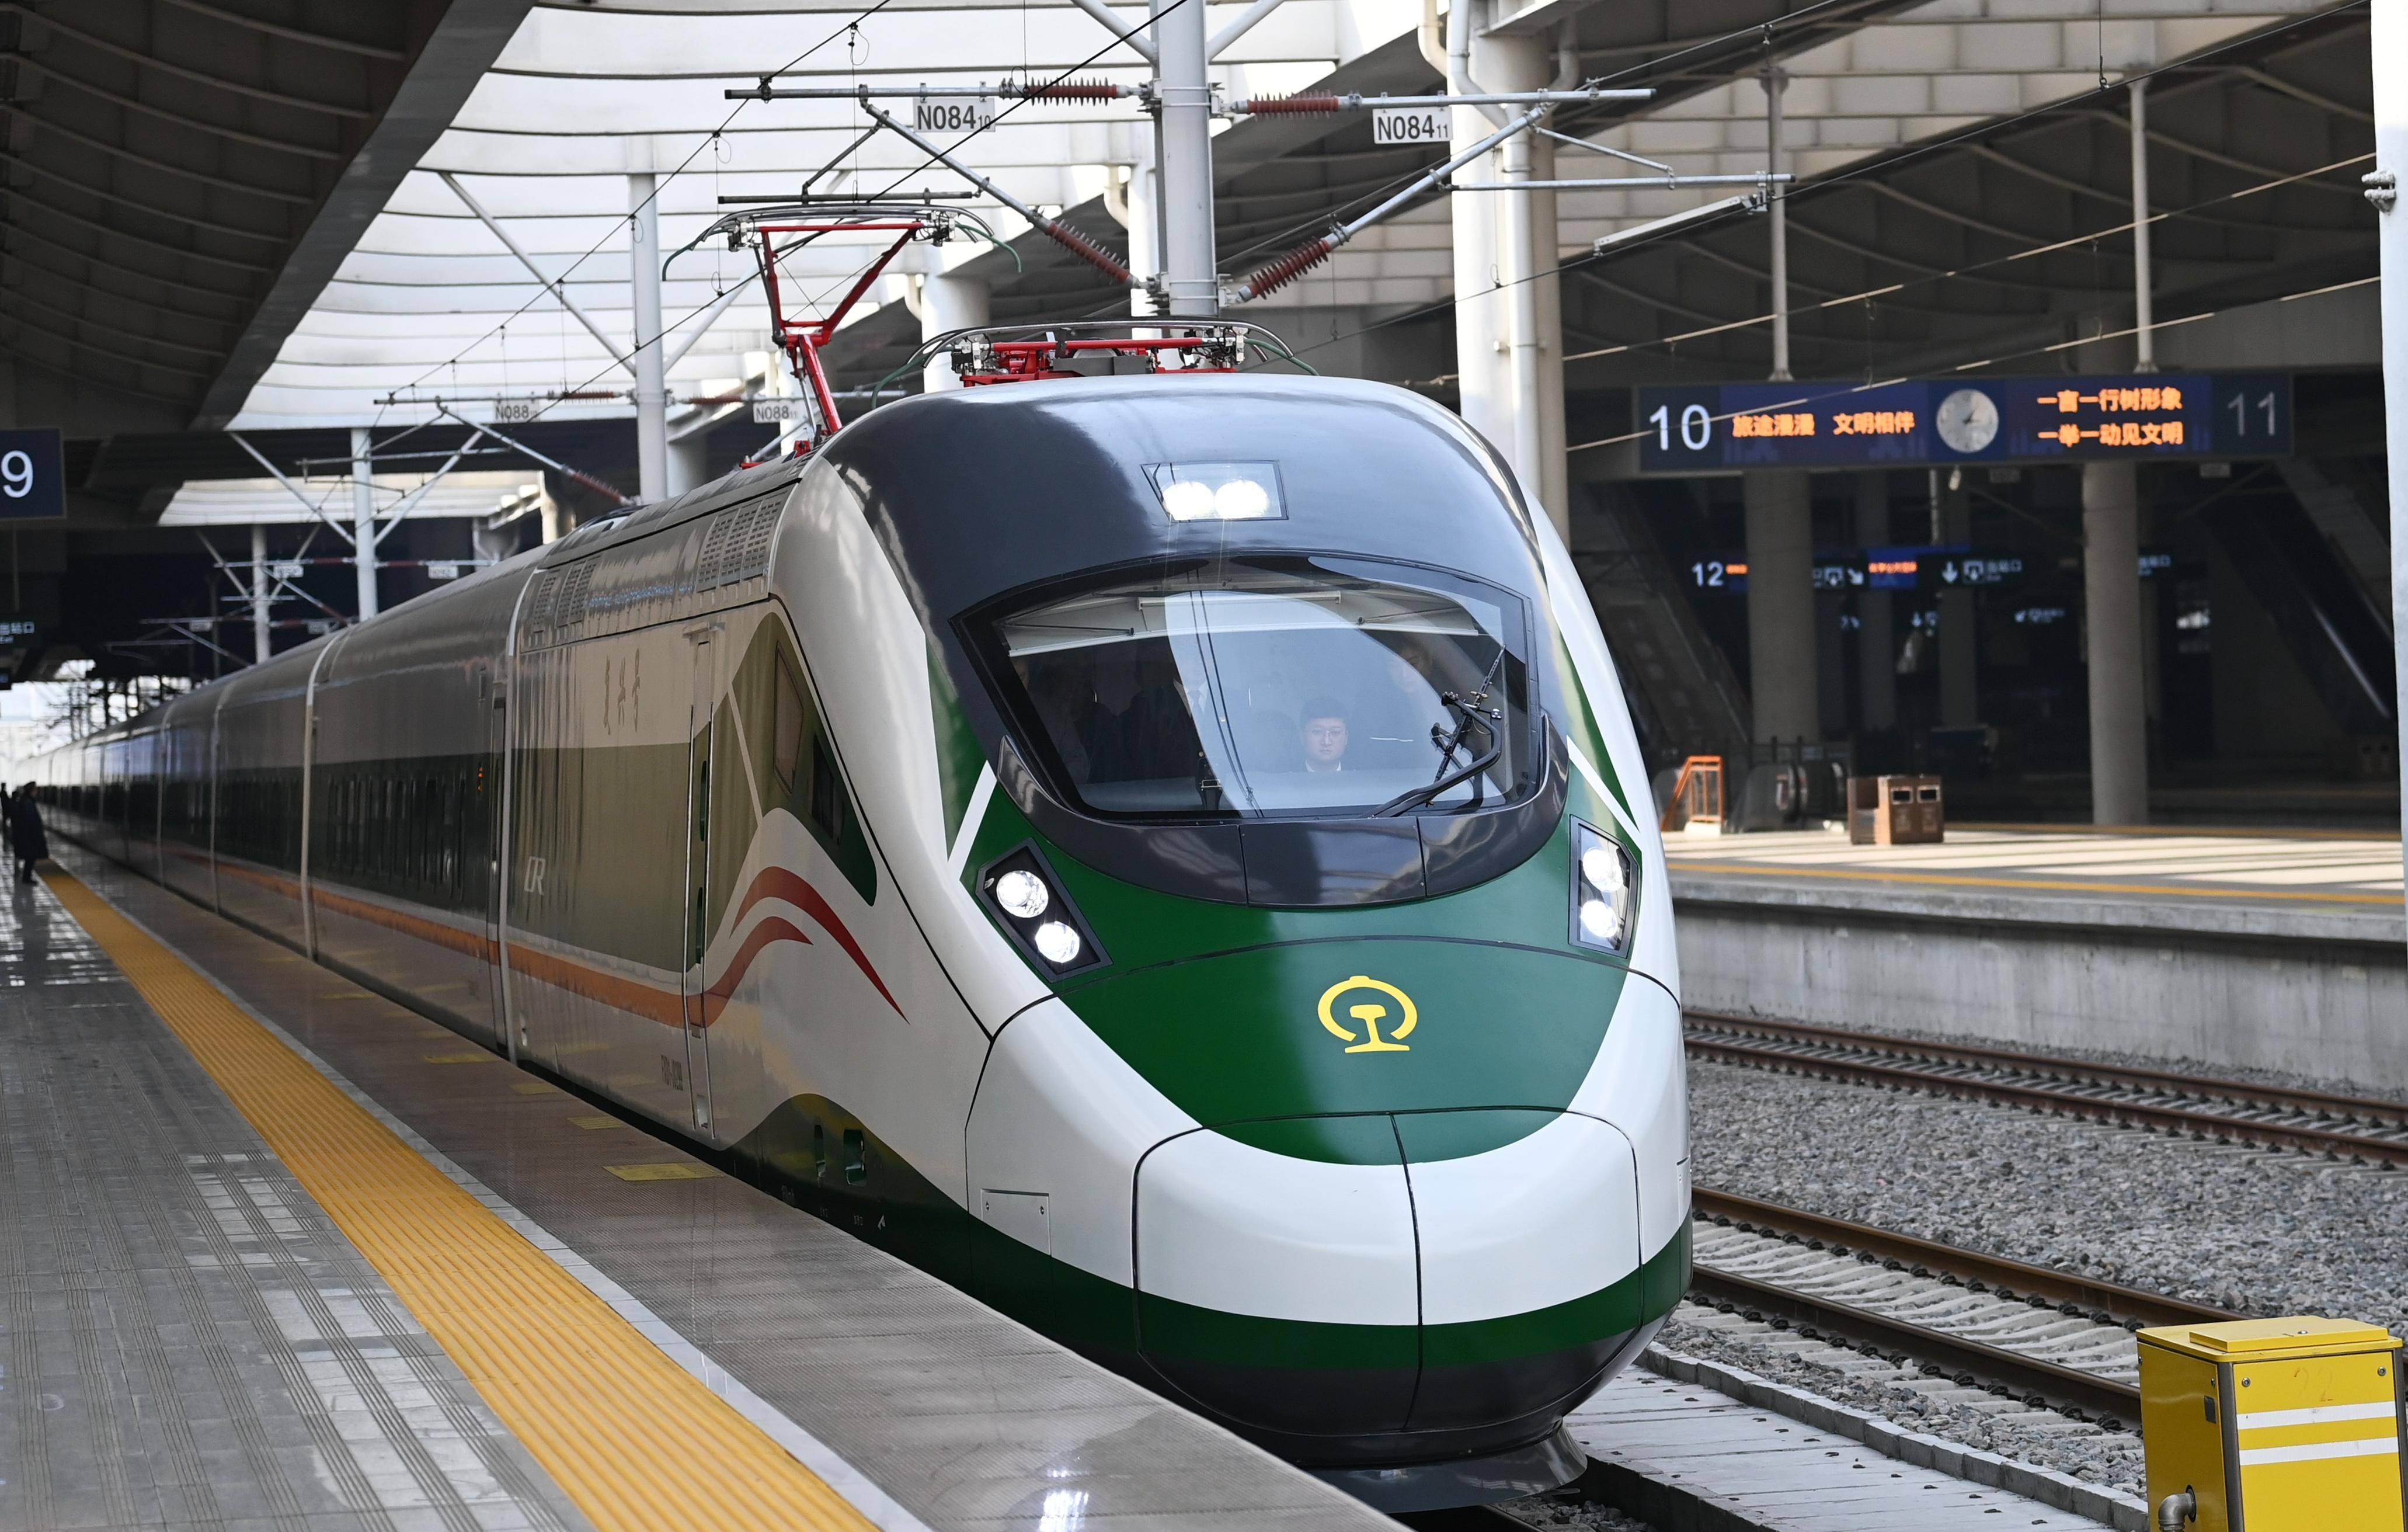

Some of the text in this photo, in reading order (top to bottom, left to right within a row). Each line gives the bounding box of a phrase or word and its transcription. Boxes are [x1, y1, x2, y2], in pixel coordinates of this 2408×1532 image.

[1650, 404, 1711, 451] 10
[1832, 411, 1915, 435] 文明相伴
[2228, 391, 2277, 437] 11
[2037, 421, 2184, 447] 一举一动见文明
[1, 450, 33, 498] 9
[1692, 561, 1724, 586] 12
